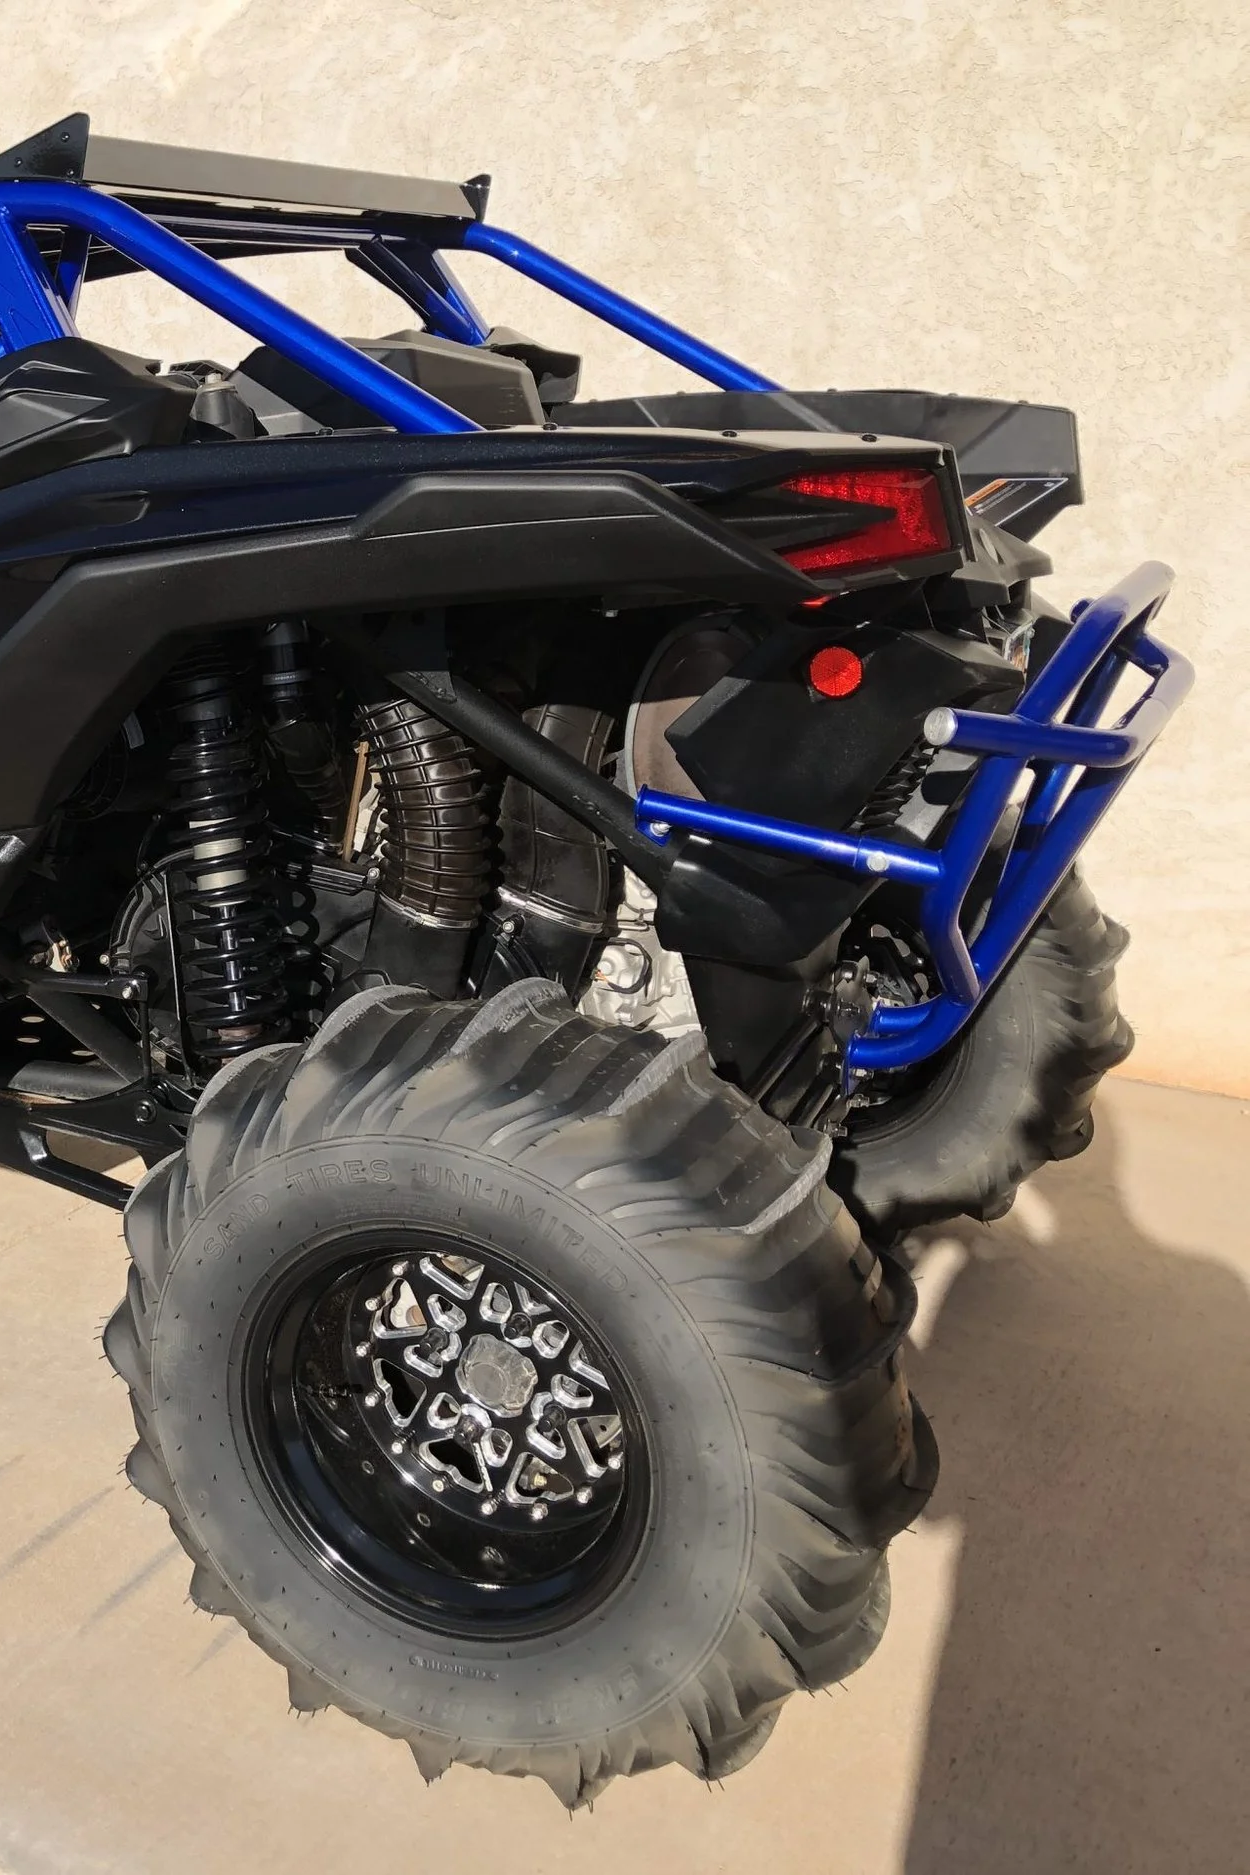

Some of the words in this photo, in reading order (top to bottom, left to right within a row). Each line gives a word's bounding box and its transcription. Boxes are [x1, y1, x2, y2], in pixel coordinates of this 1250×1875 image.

[202, 1192, 272, 1262] SAND
[287, 1159, 393, 1196] TIRES
[417, 1161, 631, 1294] UNLIMITED
